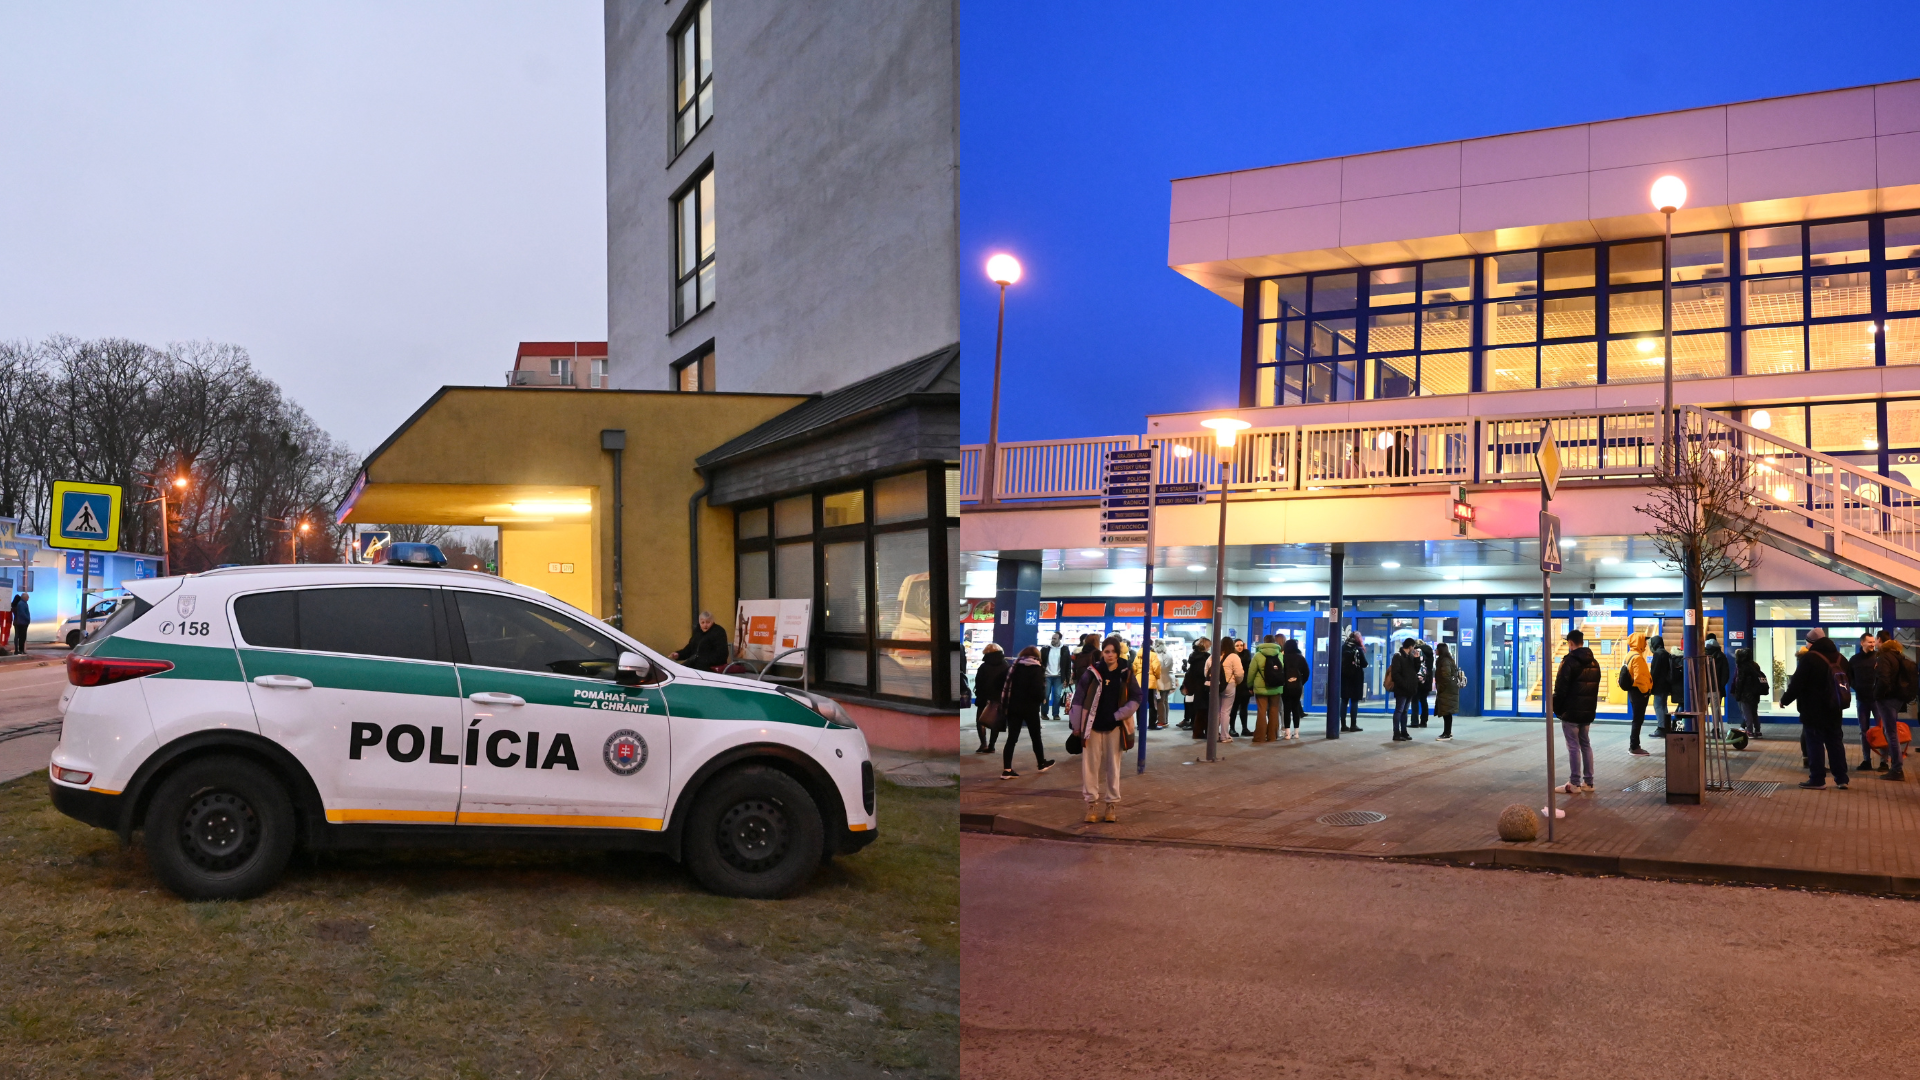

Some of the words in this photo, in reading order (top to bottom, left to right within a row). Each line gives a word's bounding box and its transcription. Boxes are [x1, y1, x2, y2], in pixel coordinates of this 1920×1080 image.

[1174, 604, 1197, 616] minit
[178, 621, 210, 636] 158
[574, 689, 626, 701] POMÁHAŤ
[601, 702, 649, 713] CHRÁNIŤ
[349, 719, 580, 770] POLÍCIA
[606, 730, 635, 747] POLICAJNÝ
